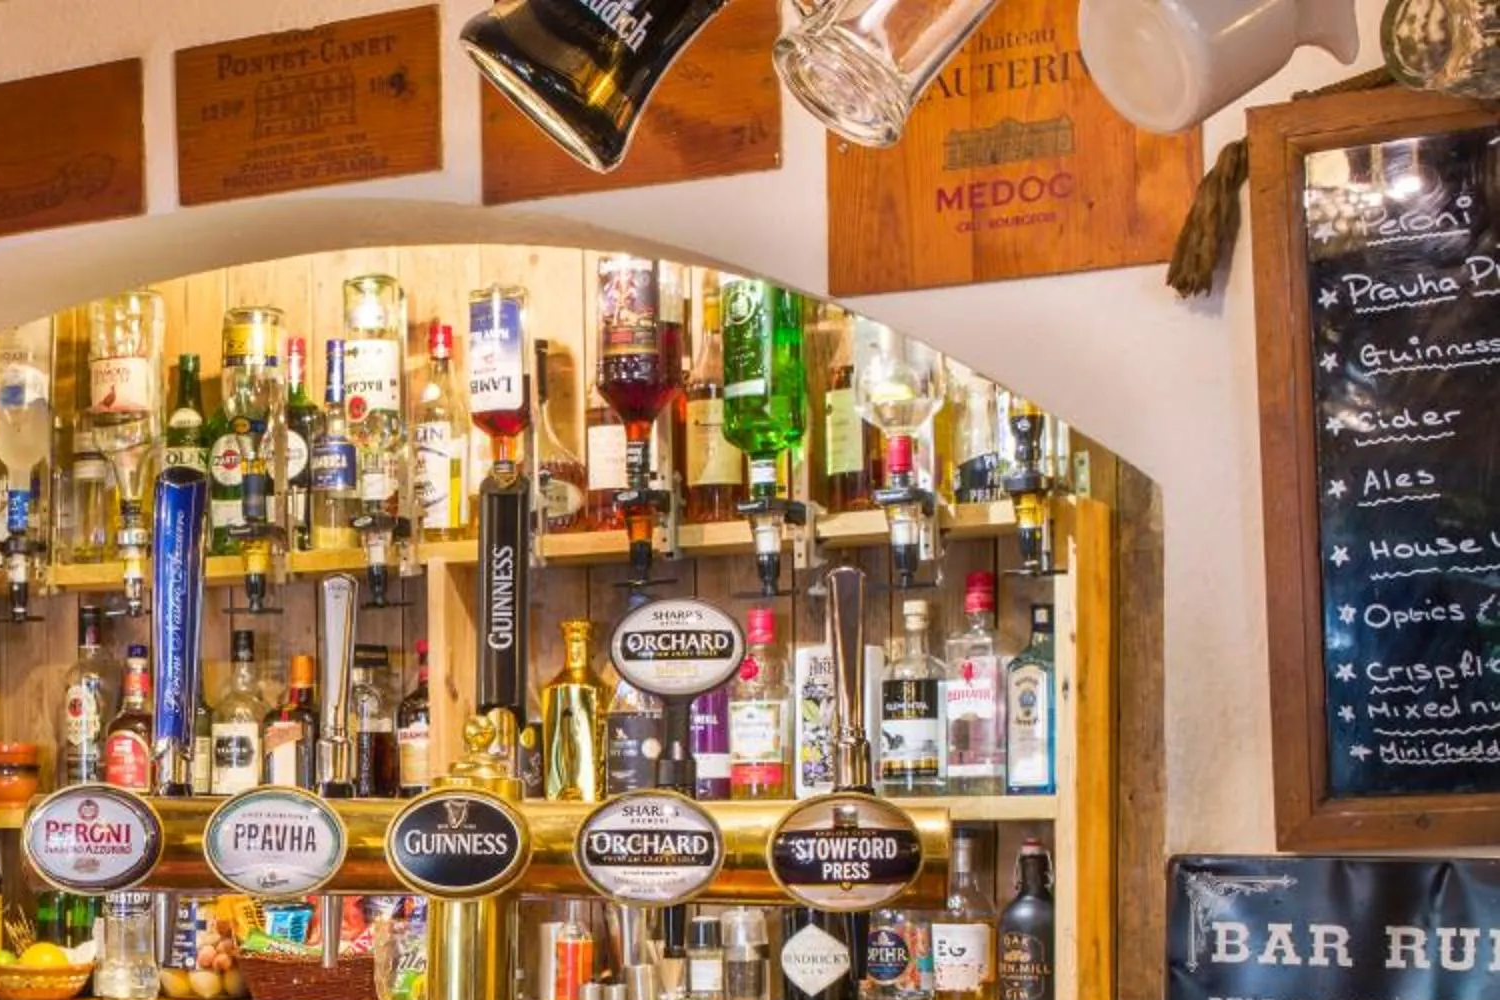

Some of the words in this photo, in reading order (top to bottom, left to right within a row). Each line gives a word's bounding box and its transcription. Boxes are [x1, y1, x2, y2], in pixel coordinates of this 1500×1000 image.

[936, 171, 1074, 213] MEDOC
[1359, 195, 1473, 237] Peroni
[1359, 336, 1500, 367] Guinness
[1363, 469, 1436, 497] Ales
[1369, 535, 1483, 560] House
[487, 544, 514, 650] GUINNESS
[1363, 598, 1466, 629] Optics
[626, 633, 729, 651] ORCHARD
[1366, 661, 1456, 689] Crisp
[1367, 694, 1461, 719] Mixed
[233, 822, 317, 853] PRAVHA
[404, 829, 509, 857] GUINNESS
[589, 832, 710, 856] ORCHARD
[796, 837, 898, 861] STOWFORD
[821, 862, 871, 881] PRESS
[1211, 921, 1354, 968] BAR
